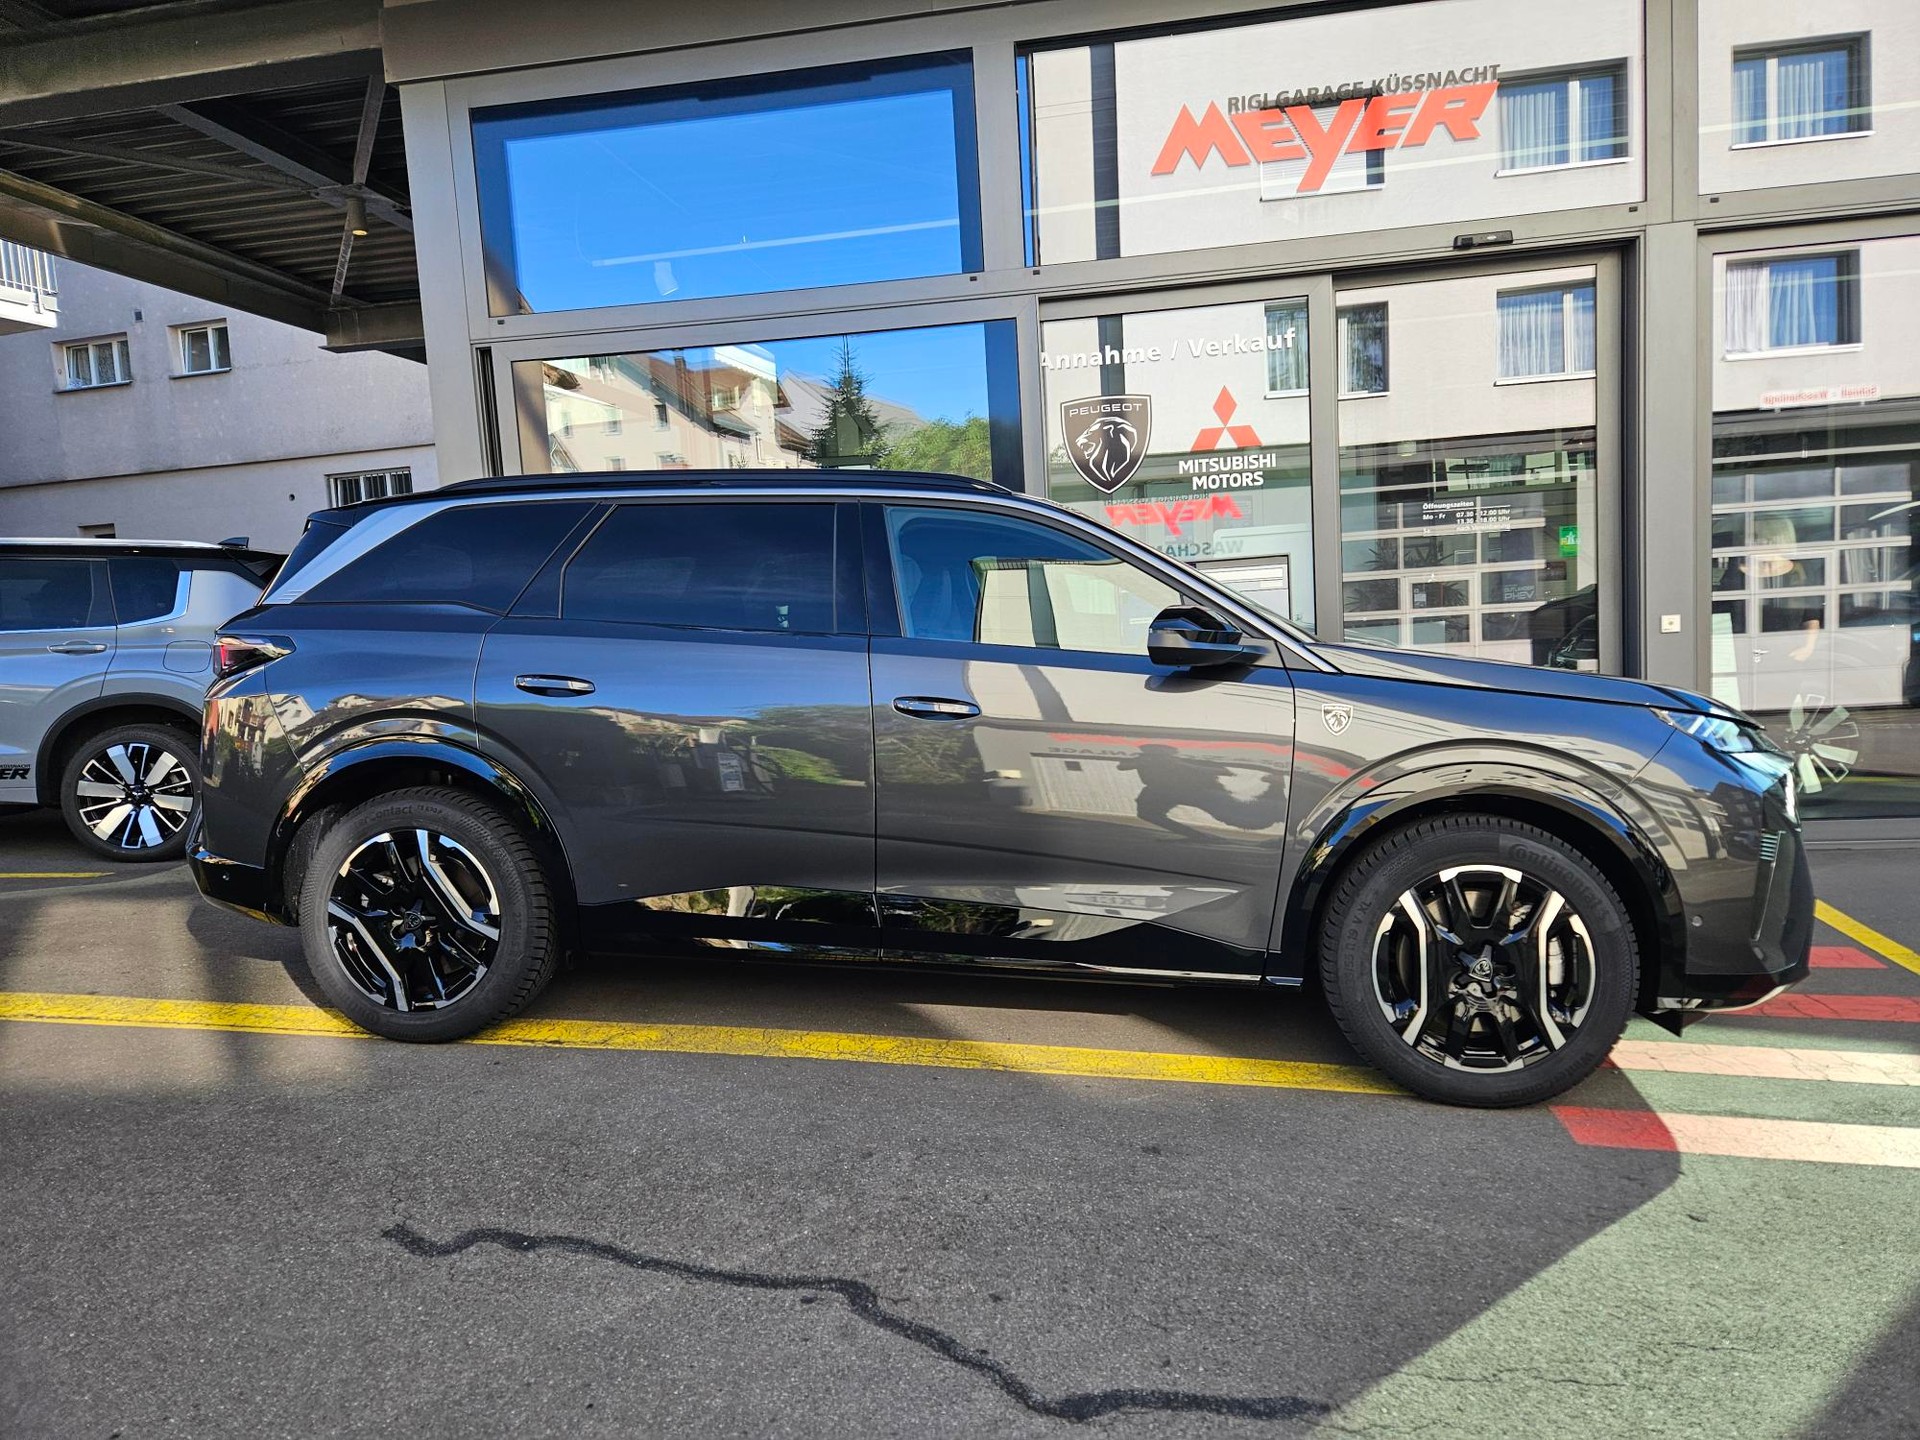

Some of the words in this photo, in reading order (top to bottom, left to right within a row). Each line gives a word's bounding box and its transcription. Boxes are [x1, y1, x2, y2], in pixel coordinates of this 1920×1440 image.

[1227, 95, 1269, 115] RIGI
[1275, 81, 1364, 109] GARAGE
[1371, 63, 1501, 97] KÜSSNACHT
[1150, 81, 1500, 194] MEYER
[1041, 344, 1162, 371] Annahme
[1170, 340, 1180, 361] /
[1188, 327, 1297, 359] Verkauf
[1069, 403, 1143, 418] PEUGEOT
[1178, 453, 1277, 475] MITSUBISHI
[1192, 471, 1265, 491] MOTORS
[1422, 500, 1475, 510] Öffnungszeiten
